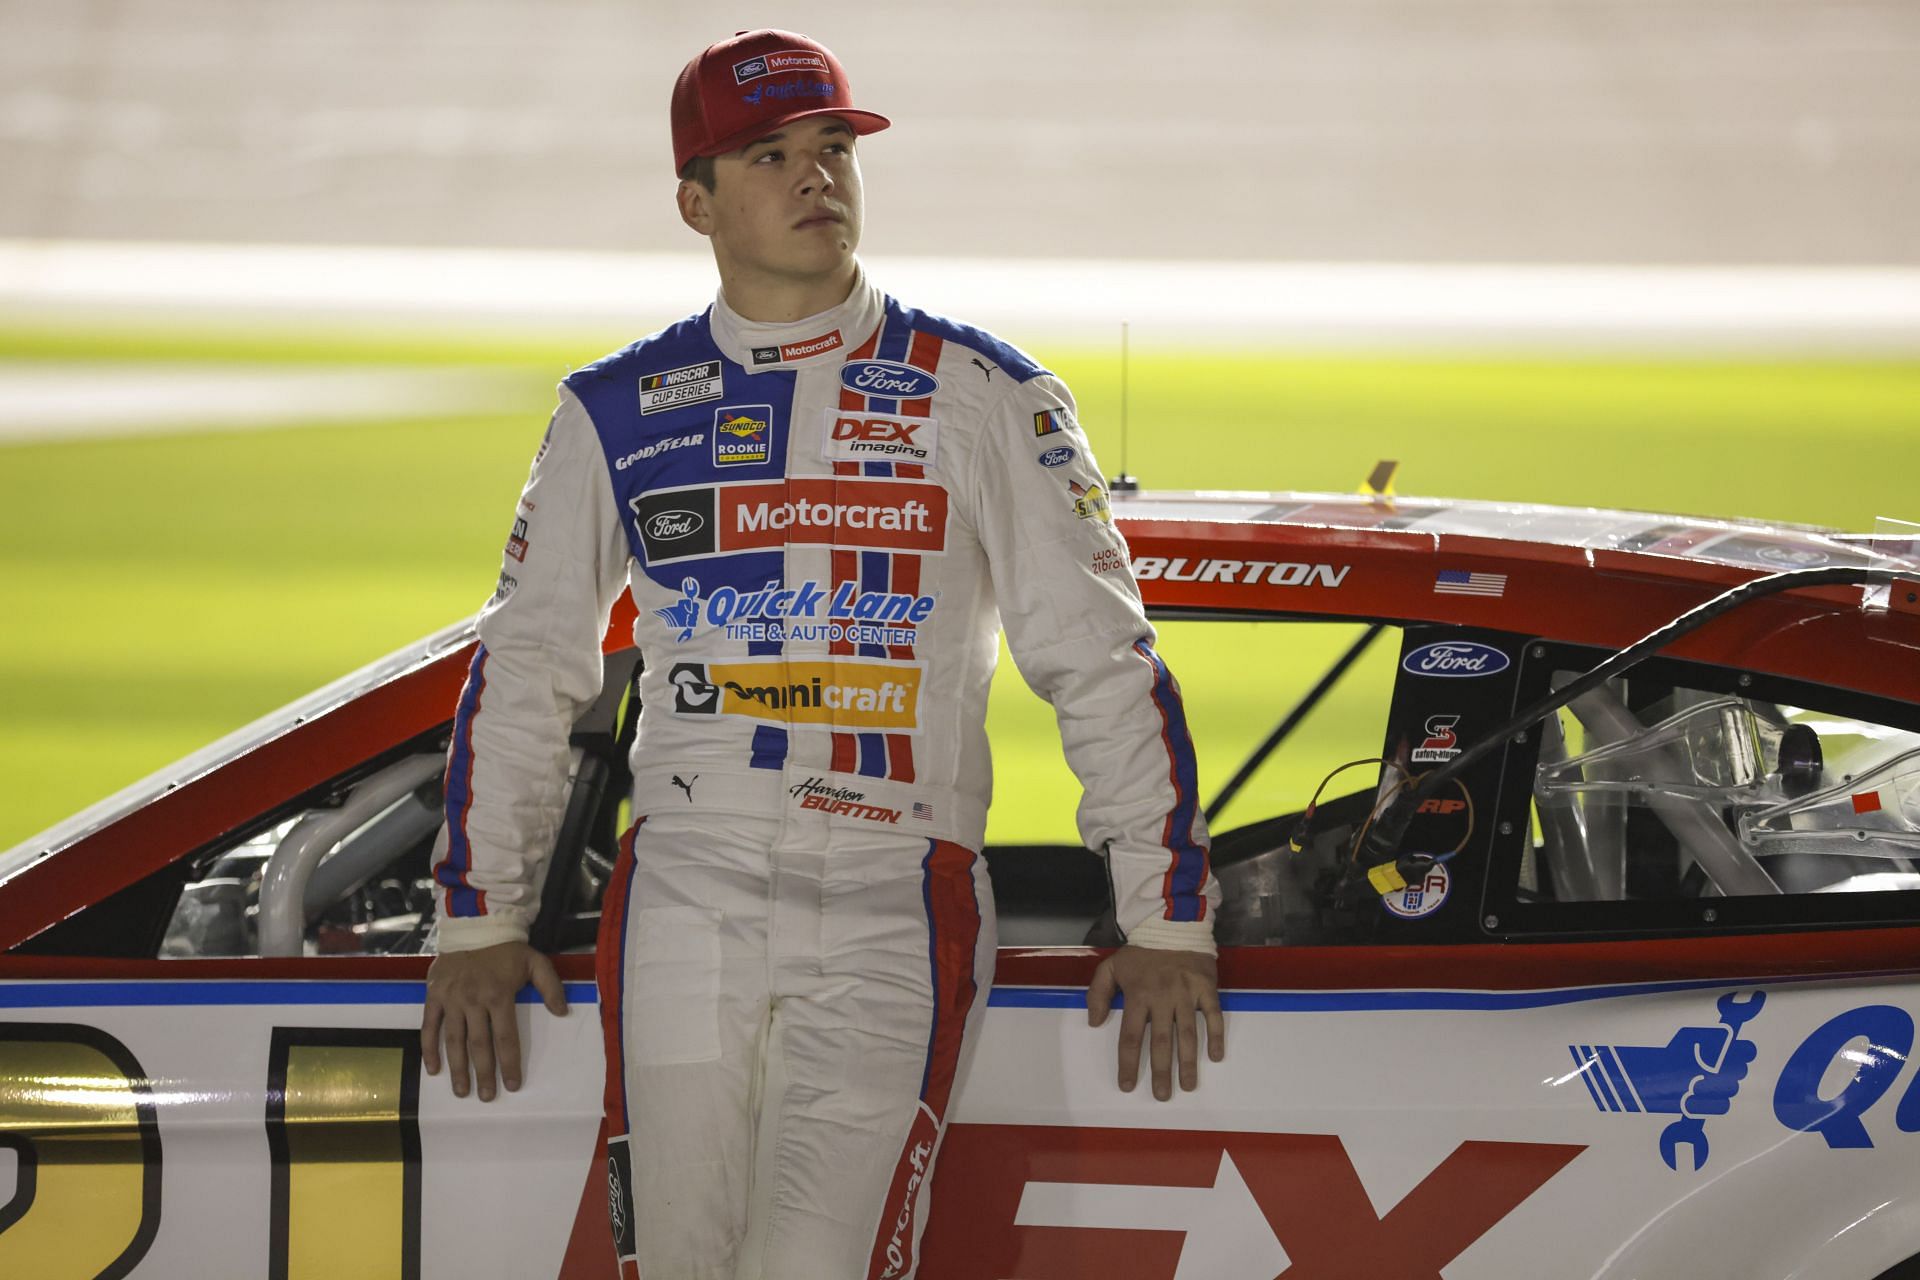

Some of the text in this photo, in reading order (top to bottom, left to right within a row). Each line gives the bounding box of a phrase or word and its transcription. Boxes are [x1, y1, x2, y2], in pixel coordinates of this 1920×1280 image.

[771, 57, 821, 67] Motorcraft
[786, 336, 838, 356] Motorcraft
[665, 366, 709, 385] NASCAR
[855, 366, 919, 392] Ford
[652, 383, 711, 404] CUP SERIES
[721, 422, 765, 431] SUNOCO
[832, 418, 920, 445] DEX
[615, 434, 704, 470] GOODYEAR
[719, 443, 766, 453] ROOKIE
[850, 441, 927, 458] imaging
[1044, 449, 1069, 466] Ford
[653, 499, 928, 537] Ford Motorcraft
[1132, 557, 1351, 587] BURTON
[707, 580, 935, 626] Quick Lane
[726, 625, 916, 645] TIRE & AUTO CENTER
[1421, 646, 1487, 671] Ford
[790, 778, 865, 801] Harrison
[800, 795, 902, 824] BURTON
[609, 1173, 622, 1227] Ford
